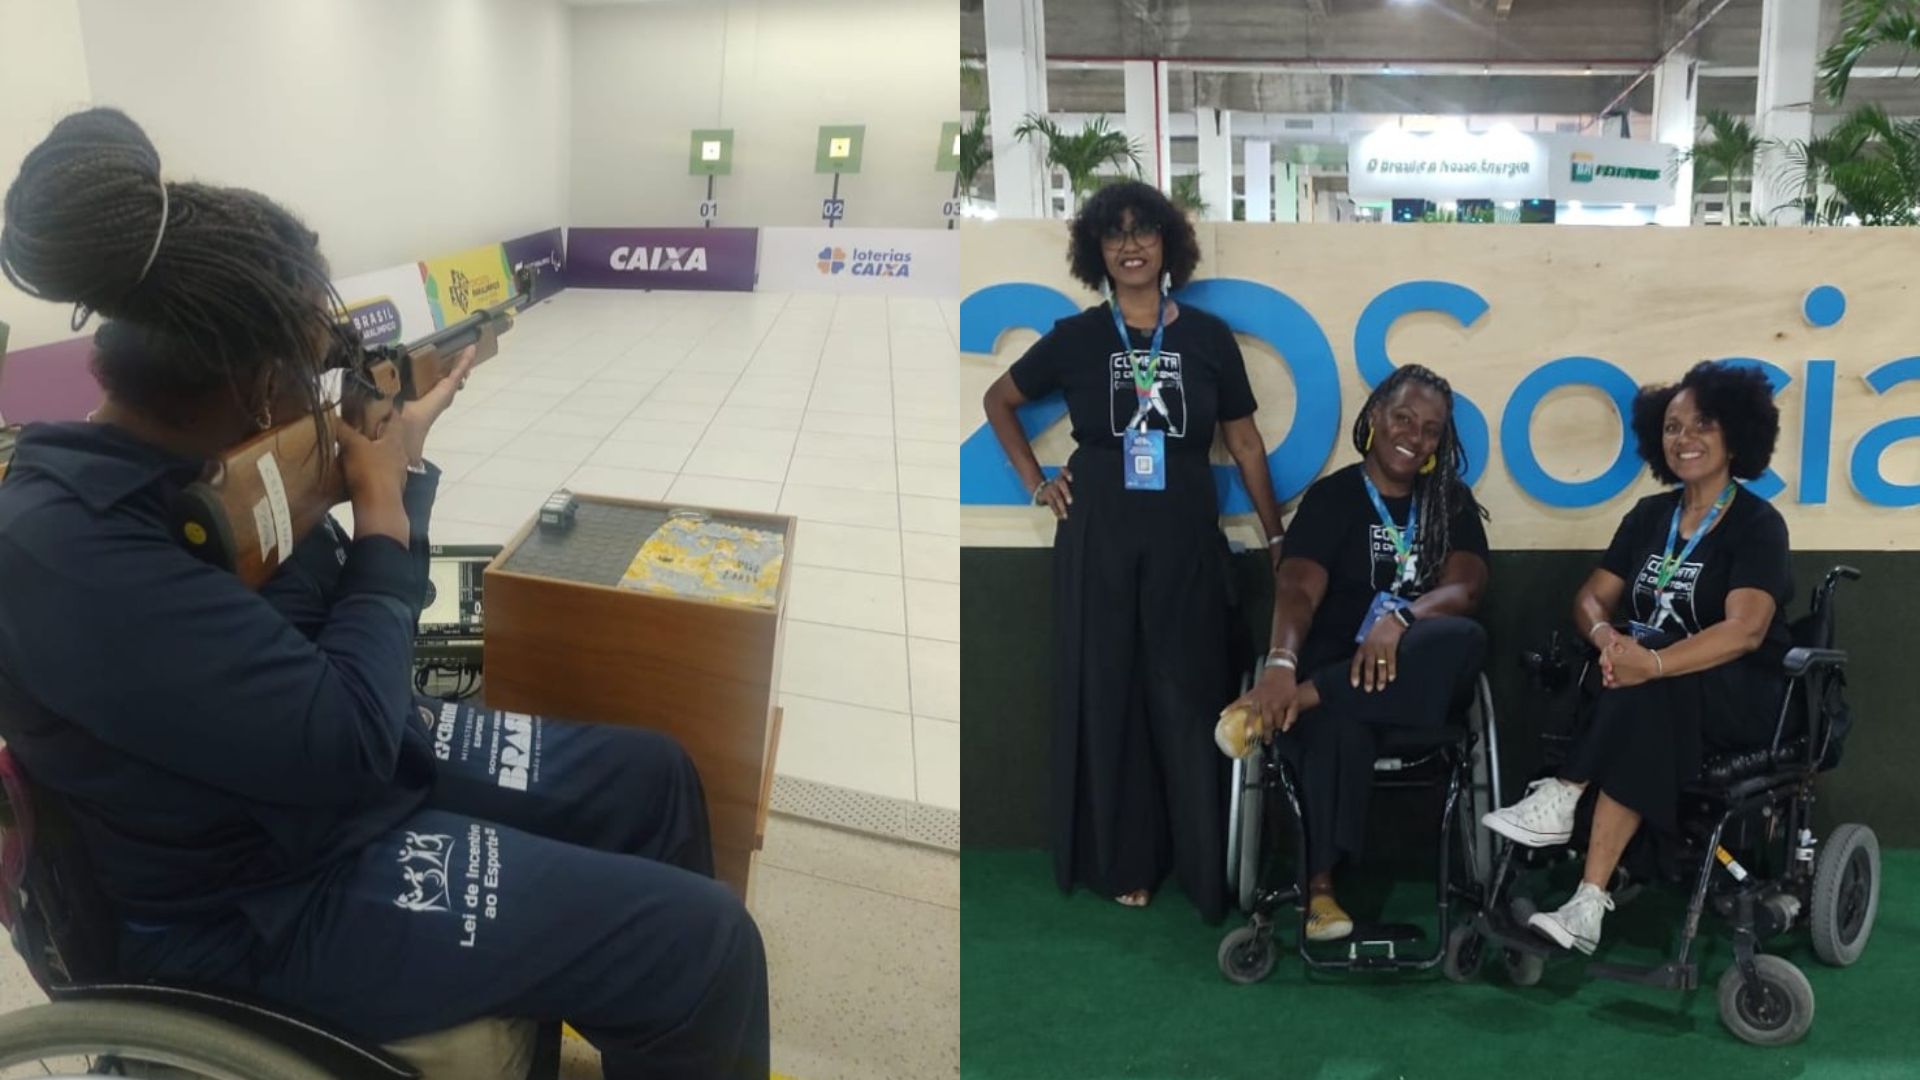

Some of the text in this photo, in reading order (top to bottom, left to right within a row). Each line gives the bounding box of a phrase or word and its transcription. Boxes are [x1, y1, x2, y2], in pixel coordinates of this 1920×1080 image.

[700, 203, 717, 217] 01
[823, 202, 844, 218] 02
[609, 246, 707, 272] CAIXA
[852, 248, 912, 263] loterias
[851, 262, 910, 277] CAIXA
[353, 308, 394, 331] BRASIL
[460, 823, 481, 948] Lei de Incentivo
[484, 893, 498, 919] ao
